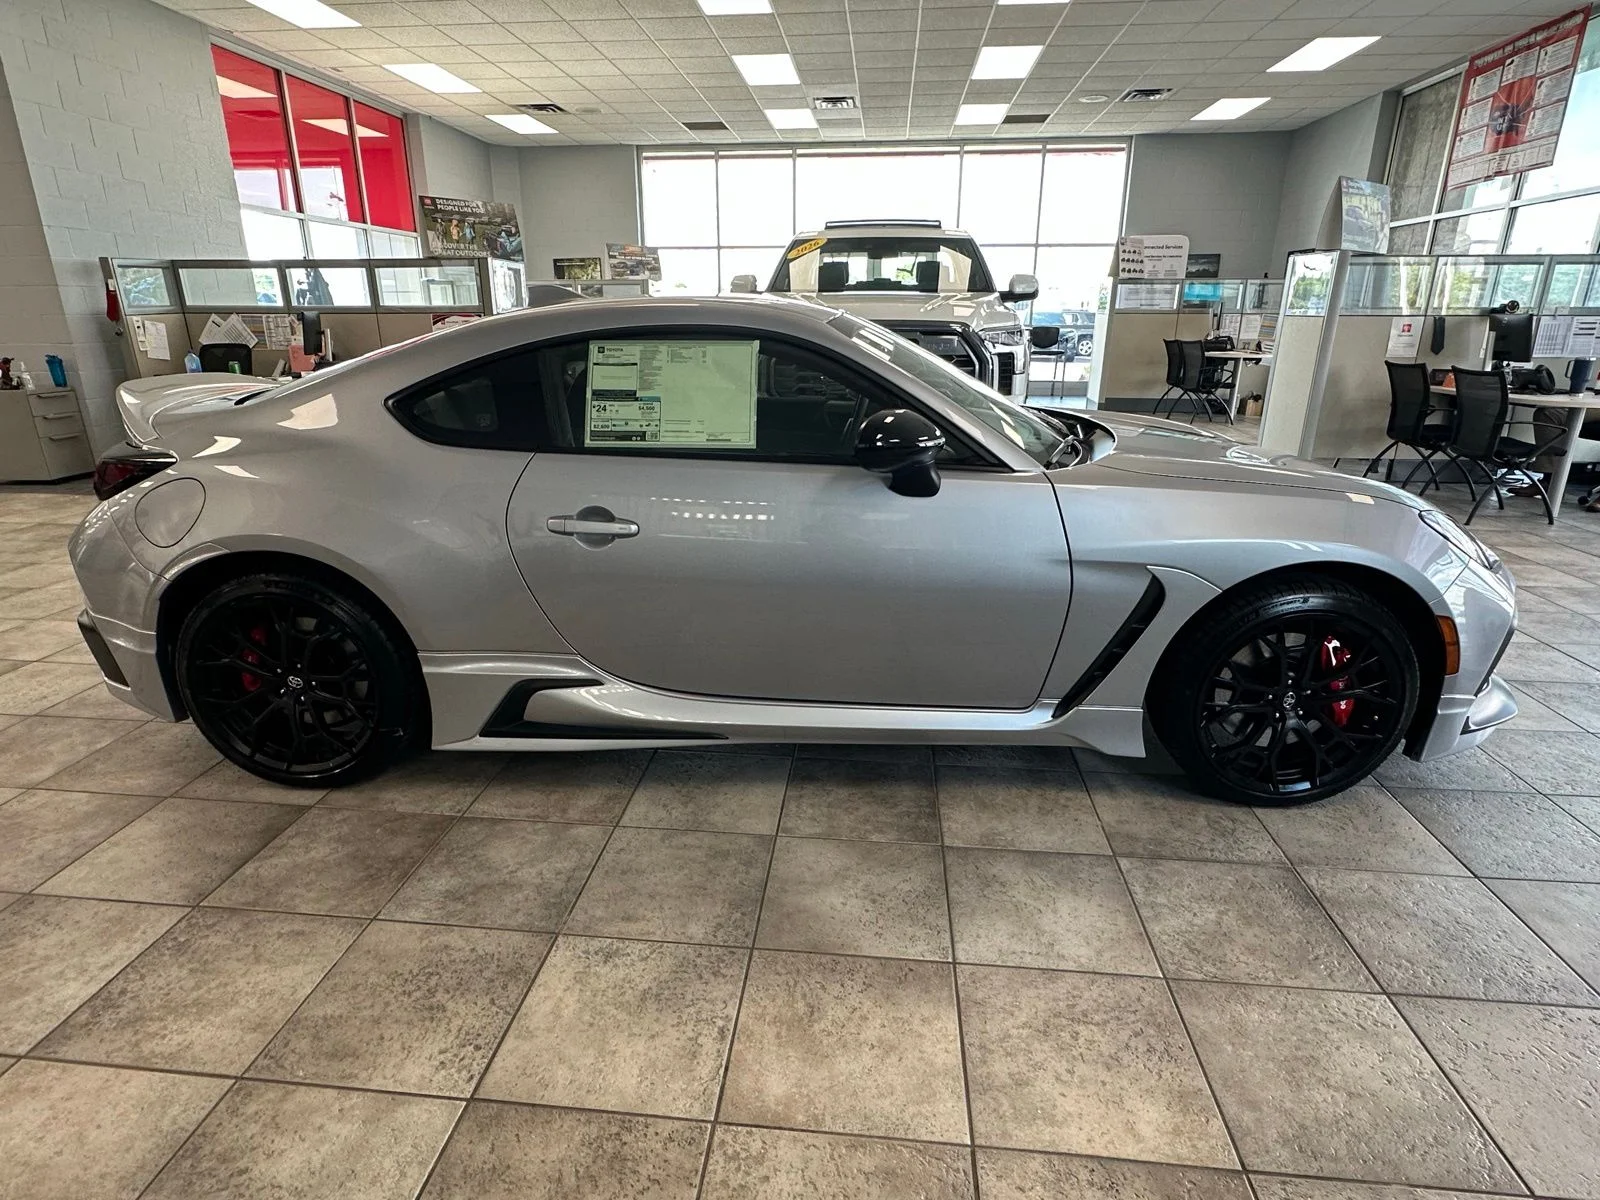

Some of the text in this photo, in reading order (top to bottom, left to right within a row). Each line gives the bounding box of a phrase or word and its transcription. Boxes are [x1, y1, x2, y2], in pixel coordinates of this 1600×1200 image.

[435, 198, 466, 206] DESIGNED
[437, 204, 459, 212] PEOPLE
[796, 240, 819, 255] 2026
[455, 249, 491, 257] OUTDOORS
[596, 404, 607, 413] 24
